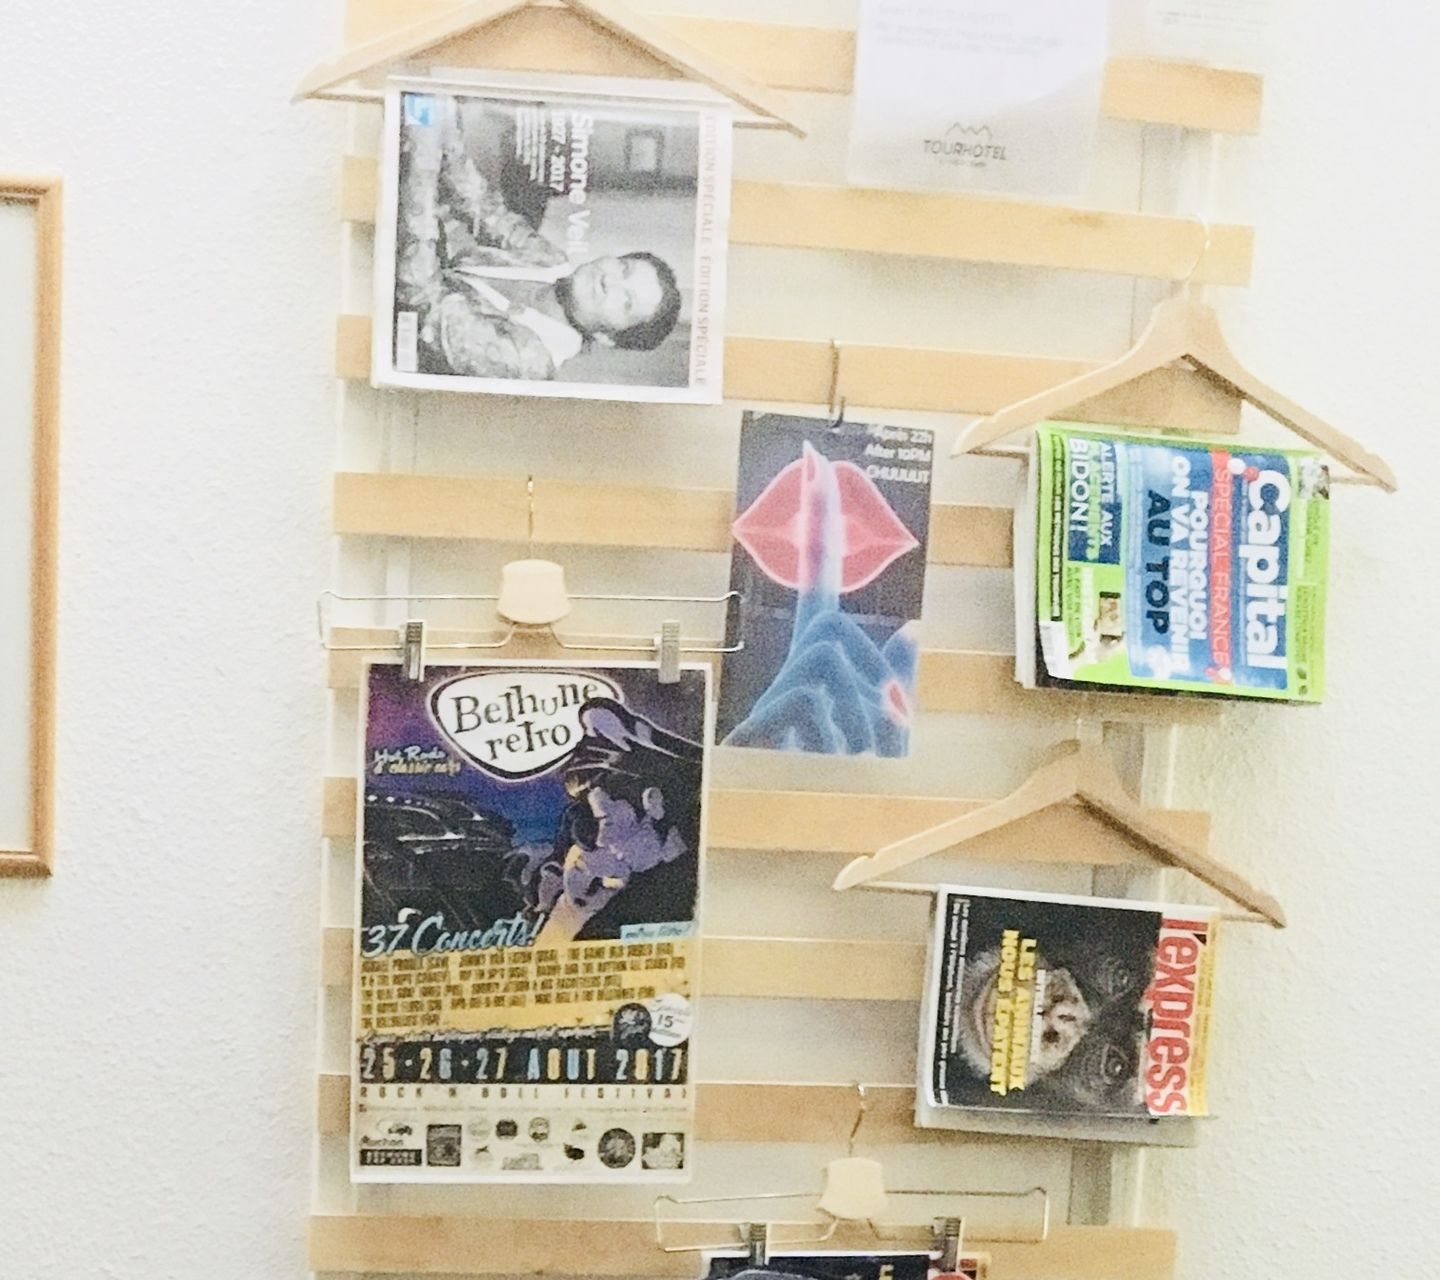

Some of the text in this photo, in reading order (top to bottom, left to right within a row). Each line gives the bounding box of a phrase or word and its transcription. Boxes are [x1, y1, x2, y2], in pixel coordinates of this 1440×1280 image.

[550, 156, 565, 191] 2017
[567, 111, 593, 254] Simone Veil
[923, 139, 1007, 161] TOURHOTEL
[1100, 441, 1115, 546] ALERTE AUX
[1145, 490, 1171, 635] AU TOP
[1169, 456, 1191, 672] ON VA REVENIR
[1188, 491, 1209, 640] POURQUOI
[1239, 470, 1291, 669] Capital
[1212, 571, 1231, 665] FRANCE
[362, 923, 409, 958] 37
[998, 930, 1019, 992] NOUS
[362, 1047, 683, 1080] 25 26 27 AOUT 2017
[1009, 938, 1037, 1091] LES ANIMAUX
